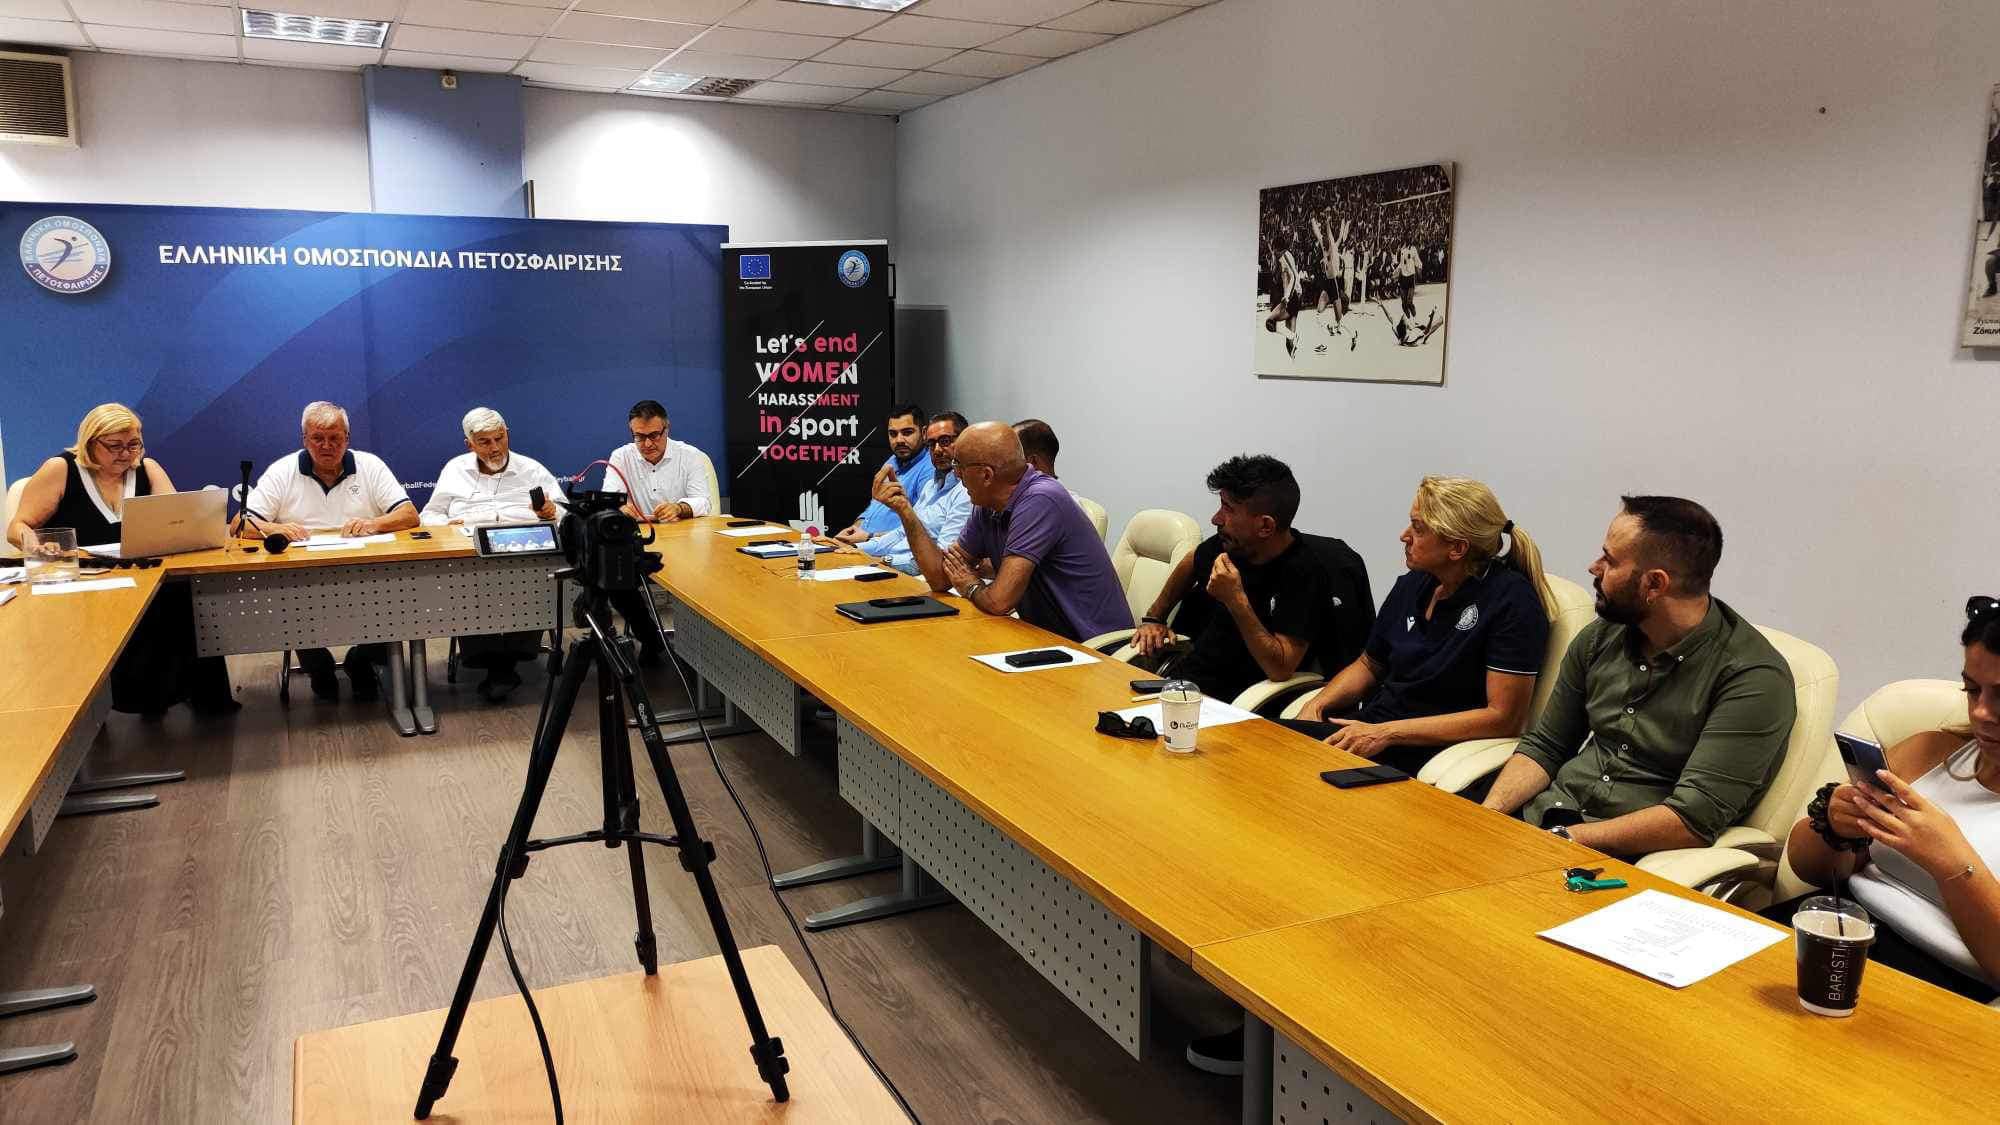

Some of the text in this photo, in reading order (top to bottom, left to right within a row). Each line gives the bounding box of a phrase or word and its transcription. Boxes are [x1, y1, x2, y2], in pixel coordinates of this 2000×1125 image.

[158, 245, 623, 271] ΕΛΛΗΝΙΚΗ ΟΜΟΣΠΟΝΔΙΑ ΠΕΤΟΣΦΑΙΡΙΣΗΣ
[814, 333, 857, 352] end
[755, 361, 858, 384] WOMEN
[758, 393, 860, 406] HARASSMENT
[760, 409, 858, 440] in sport
[758, 445, 860, 464] TOGETHER
